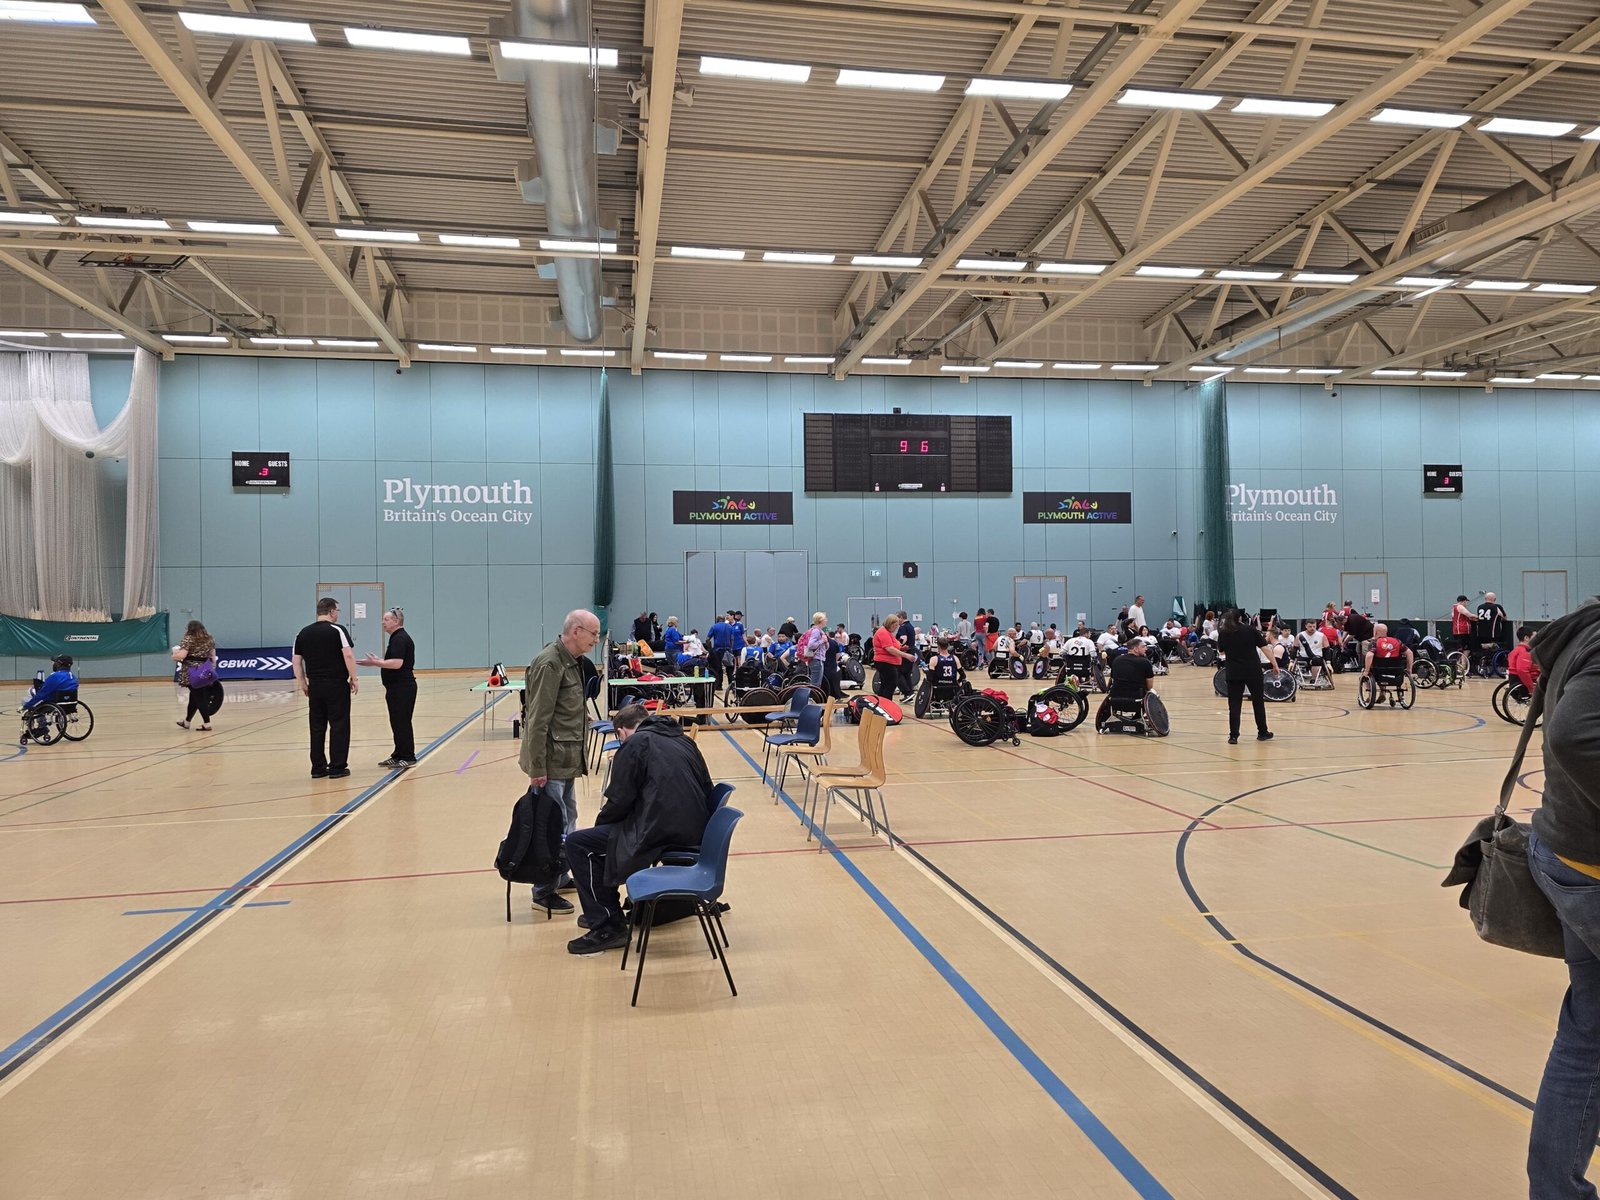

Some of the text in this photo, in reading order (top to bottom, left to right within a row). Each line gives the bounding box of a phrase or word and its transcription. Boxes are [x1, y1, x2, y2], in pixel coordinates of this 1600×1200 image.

[900, 440, 929, 452] 9 6
[383, 478, 533, 509] Plymouth
[1225, 483, 1338, 510] Plymouth
[383, 509, 533, 525] Britain's Ocean City
[689, 512, 778, 520] PLYMOUTH ACTIVE
[1037, 511, 1118, 520] PLYMOUTH ACTIVE
[1275, 510, 1311, 522] Ocean
[1314, 510, 1338, 524] City
[1478, 608, 1492, 621] 24
[999, 638, 1005, 647] 5
[753, 650, 760, 661] 2
[1070, 646, 1086, 656] 21
[218, 659, 258, 669] GBWR
[943, 665, 953, 677] 33
